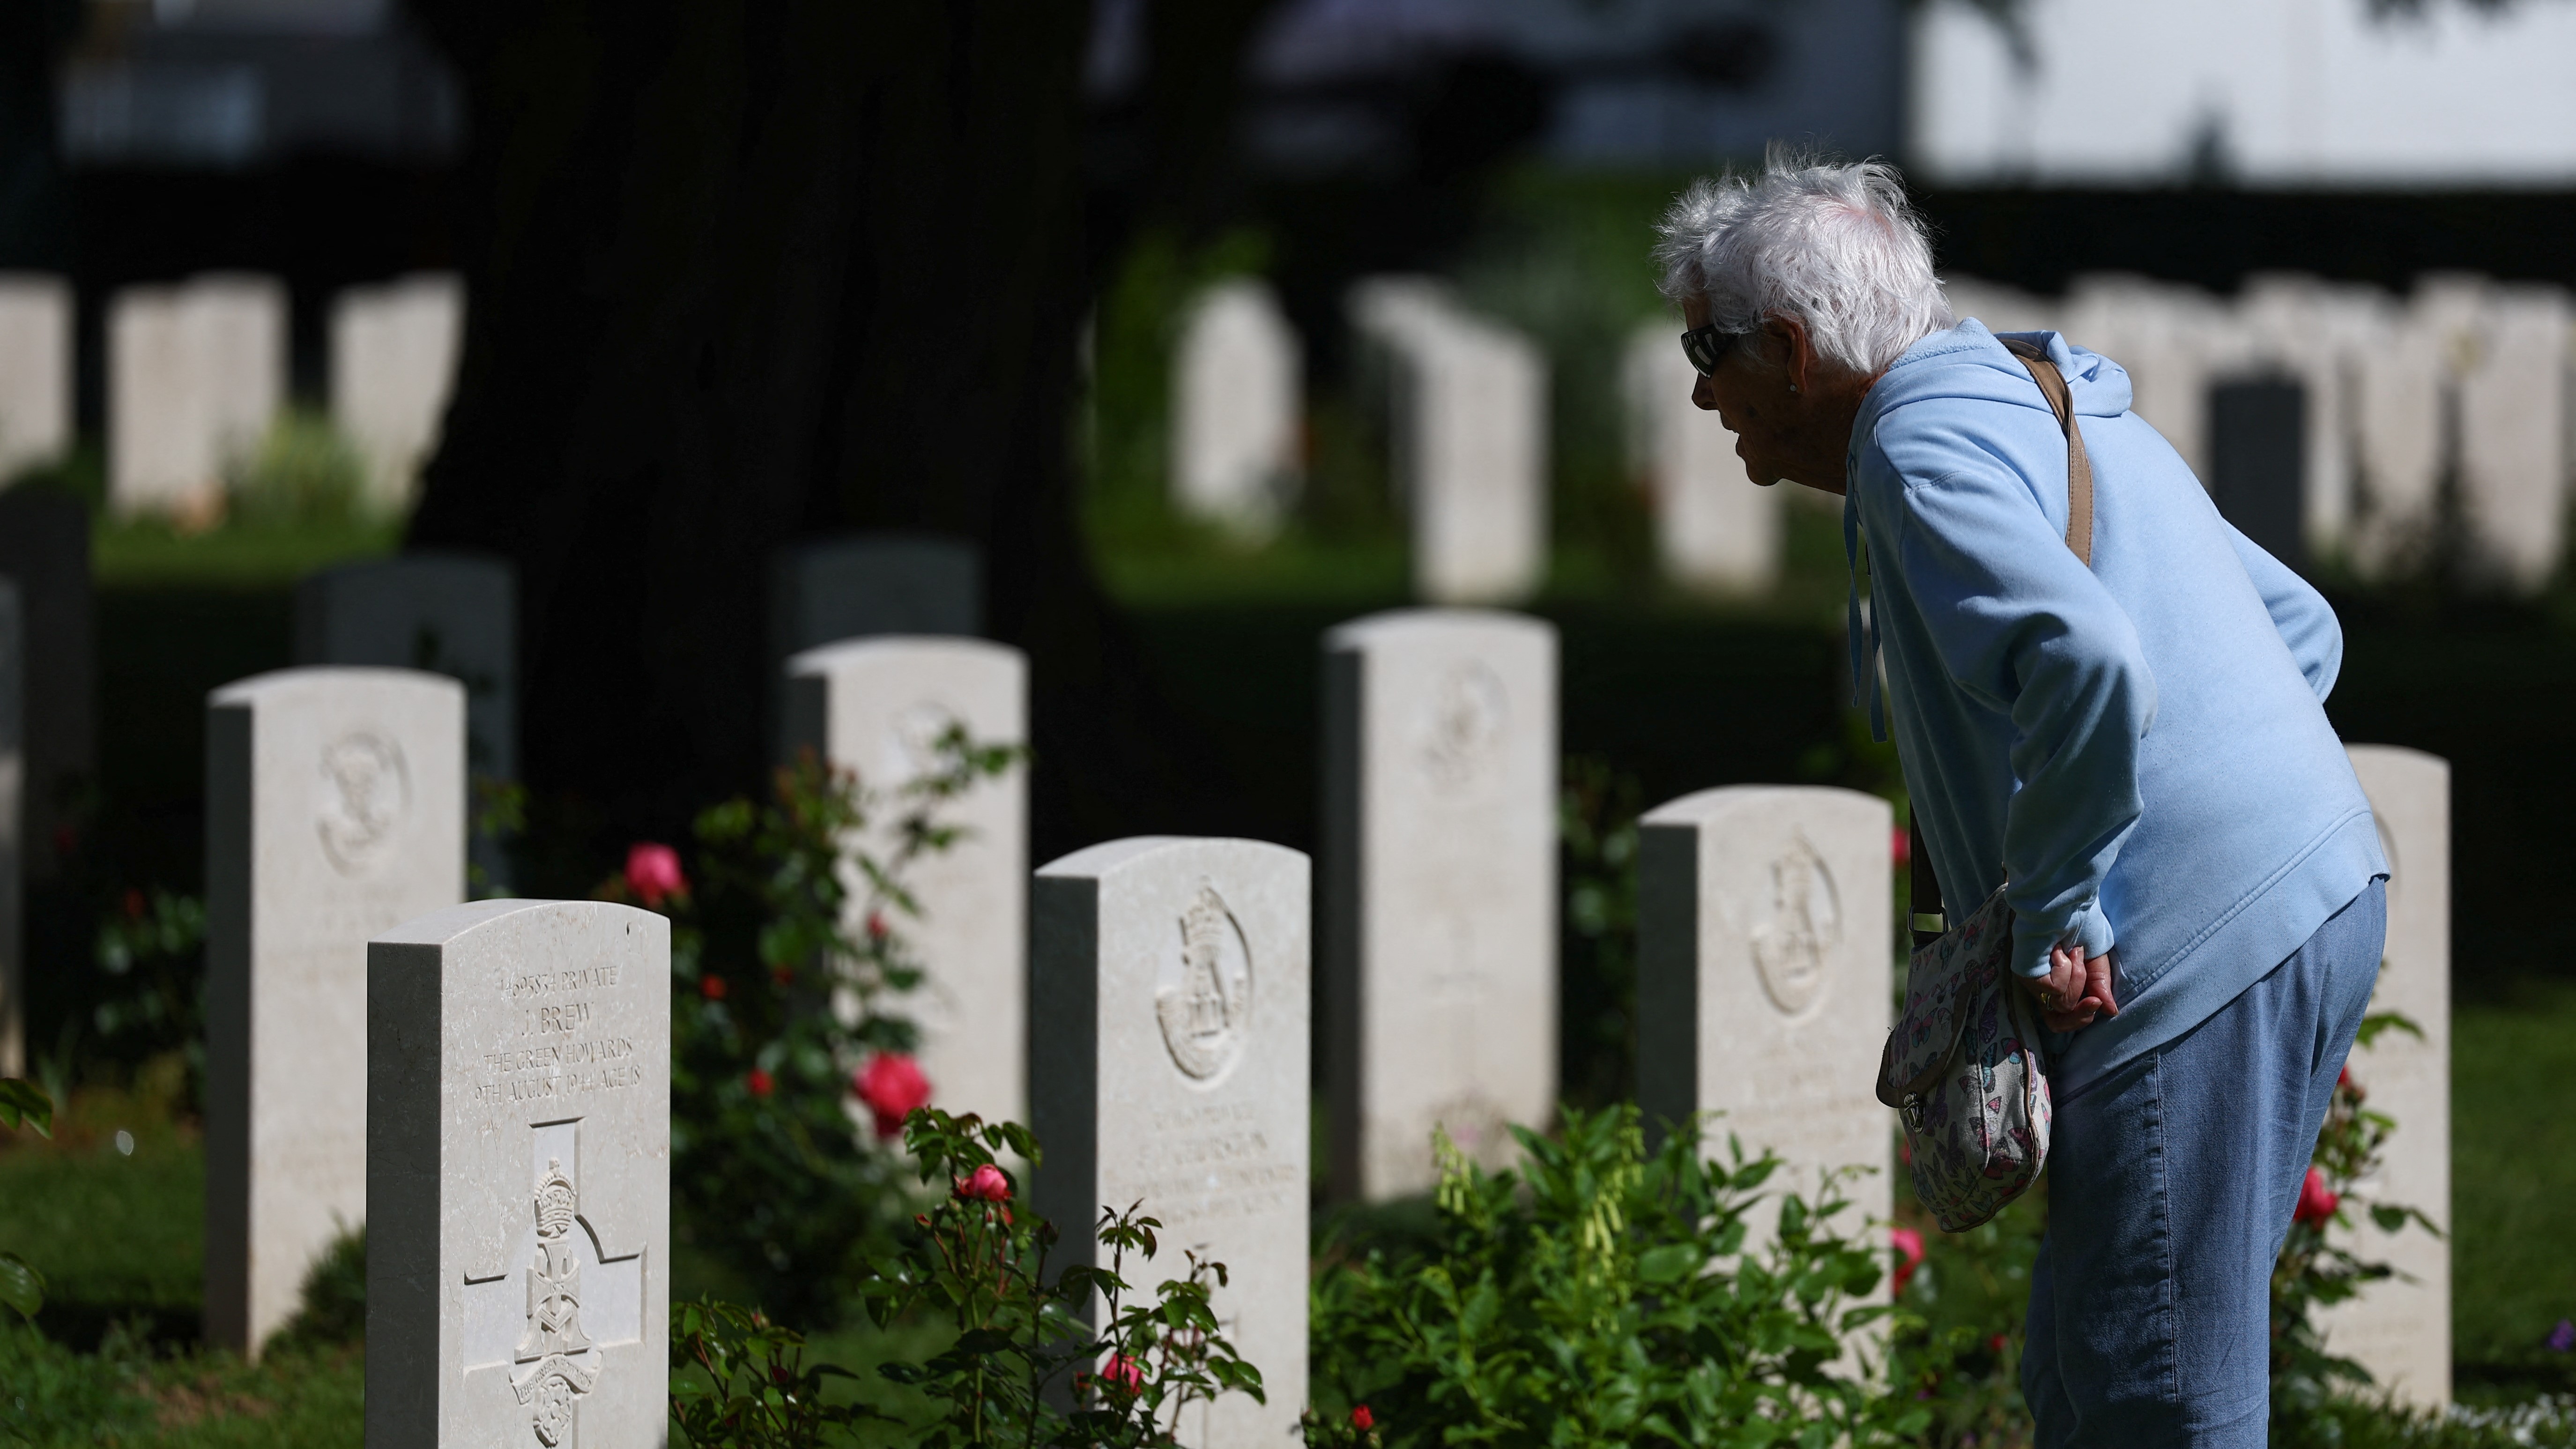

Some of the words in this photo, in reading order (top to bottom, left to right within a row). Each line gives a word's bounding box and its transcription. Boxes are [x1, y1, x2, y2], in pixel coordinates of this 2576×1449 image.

[561, 966, 617, 992] PRIVATE
[521, 1010, 534, 1036] J.
[540, 1001, 595, 1035] BREW
[483, 1052, 511, 1074] THE
[516, 1046, 561, 1070] GREEN
[566, 1037, 633, 1064] HOWARDS
[475, 1083, 502, 1105] 9TH
[509, 1076, 562, 1101] AUGUST
[566, 1072, 593, 1095] 1944
[600, 1067, 625, 1089] AGE
[630, 1064, 641, 1086] 18
[518, 1379, 535, 1399] THE
[535, 1357, 558, 1384] GREEN
[560, 1358, 593, 1388] HOWARDS
